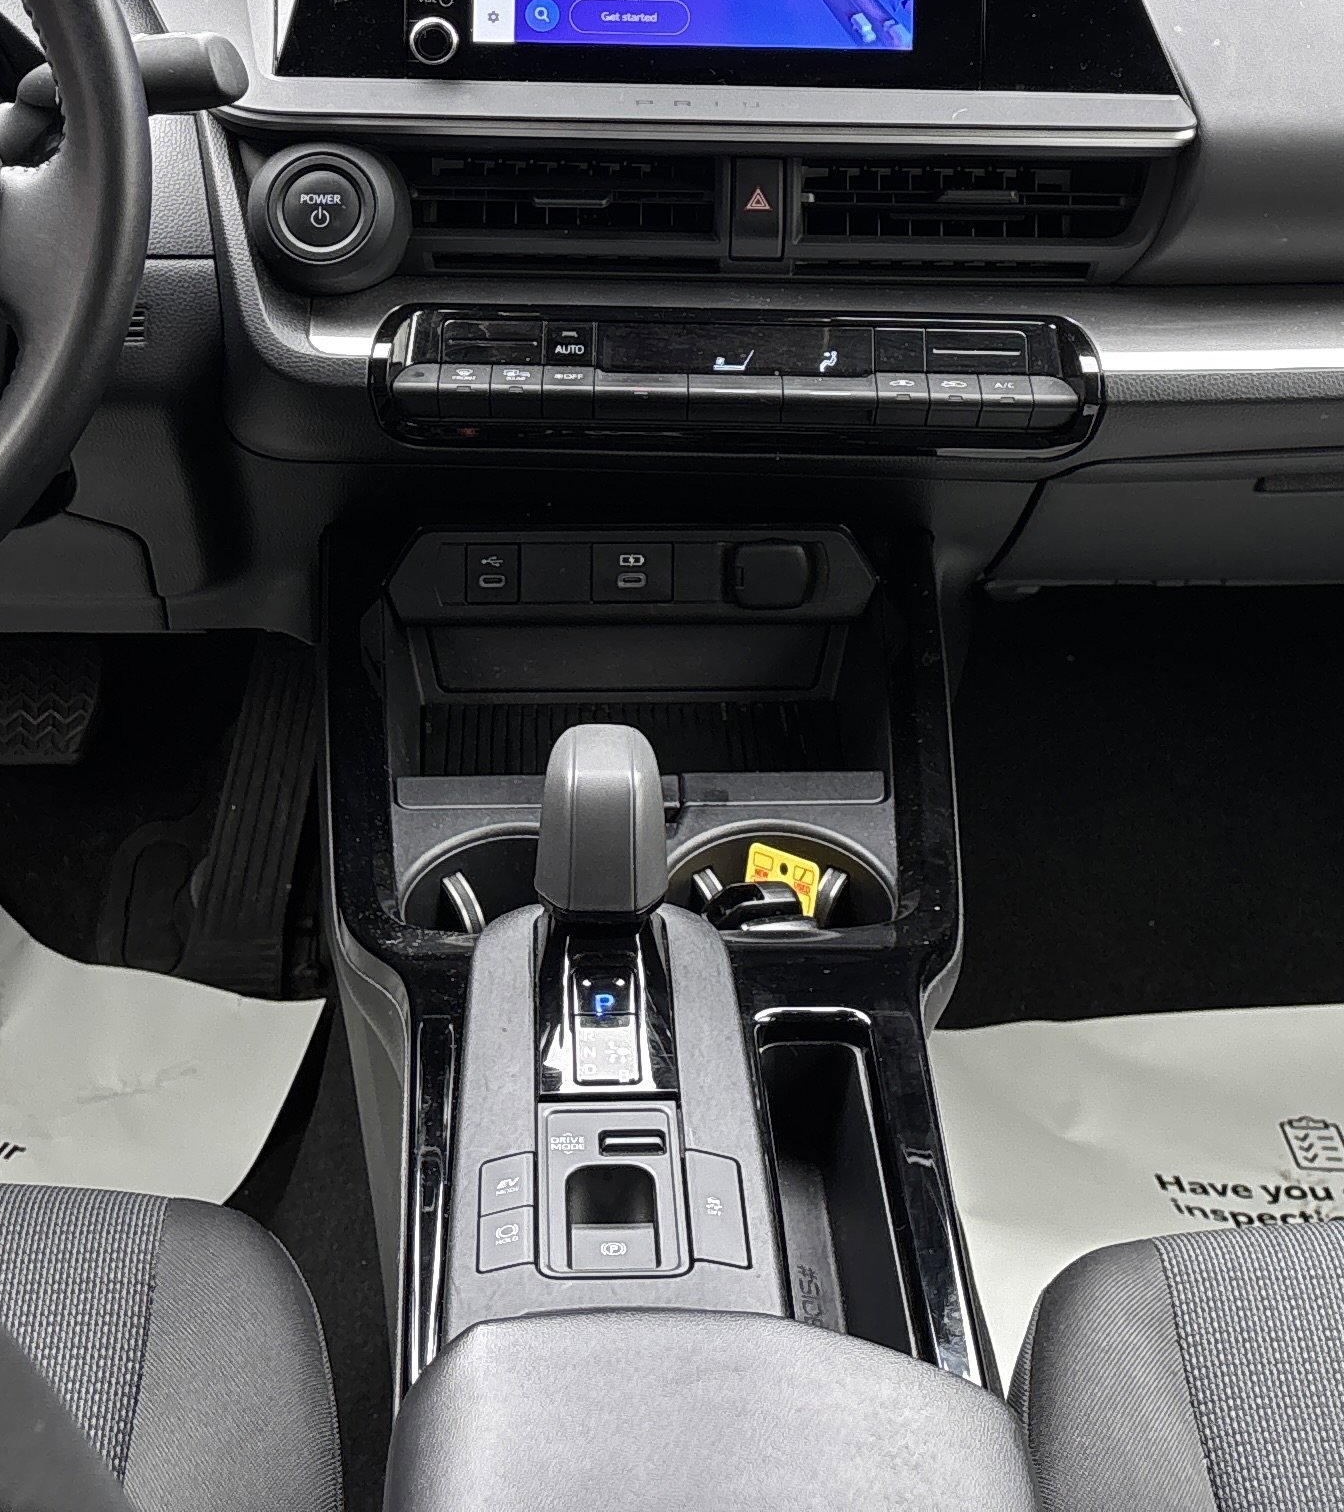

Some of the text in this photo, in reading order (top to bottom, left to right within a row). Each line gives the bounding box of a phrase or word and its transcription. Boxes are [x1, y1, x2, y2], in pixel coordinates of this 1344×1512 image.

[600, 11, 658, 23] Get started
[299, 193, 342, 205] POWER
[554, 344, 585, 355] AUTO
[594, 993, 615, 1016] P
[550, 1136, 585, 1144] DRIVE
[1154, 1173, 1255, 1200] Have
[1261, 1183, 1335, 1204] you
[495, 1235, 519, 1246] HOLD
